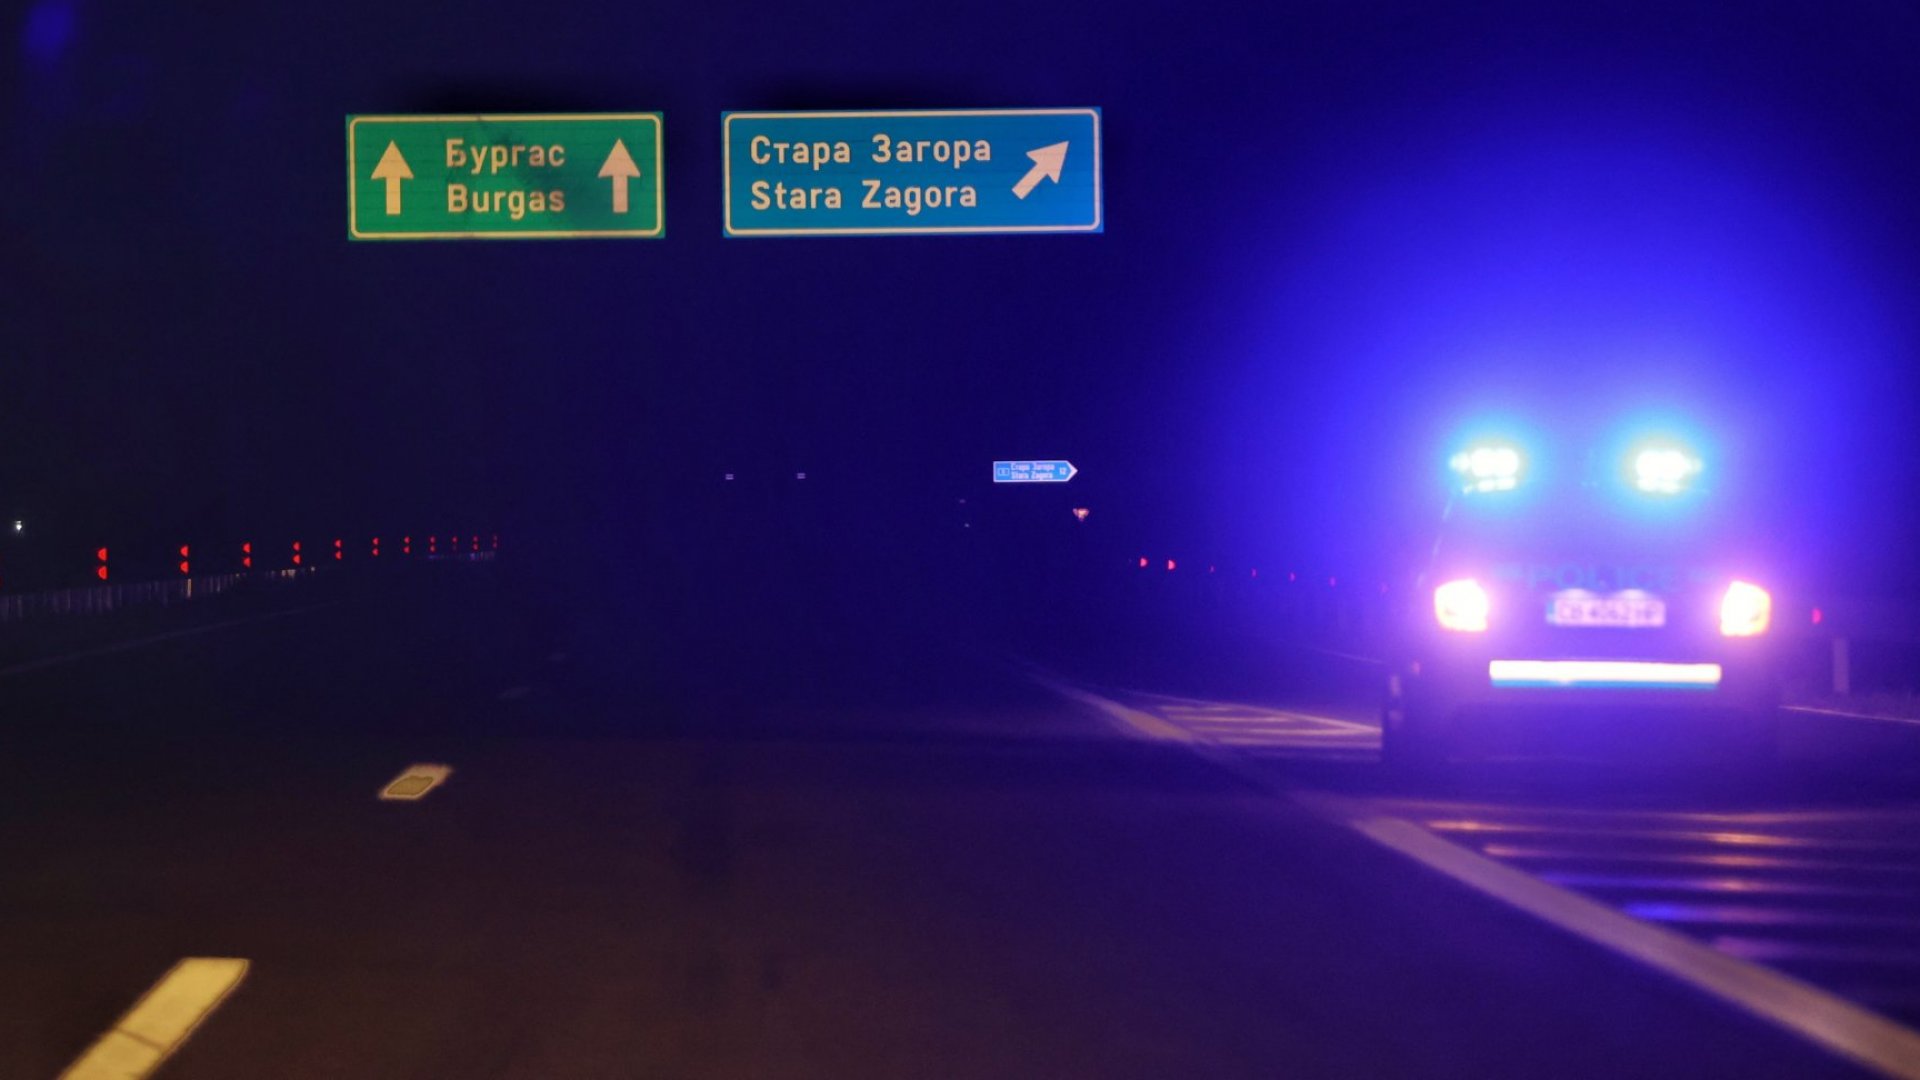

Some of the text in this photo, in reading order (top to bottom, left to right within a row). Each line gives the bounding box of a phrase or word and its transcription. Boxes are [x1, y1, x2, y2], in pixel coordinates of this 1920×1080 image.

[447, 138, 565, 175] Бургас
[750, 133, 991, 171] Стара Загора
[448, 183, 565, 220] Burgas
[751, 179, 977, 216] Stara Zagora
